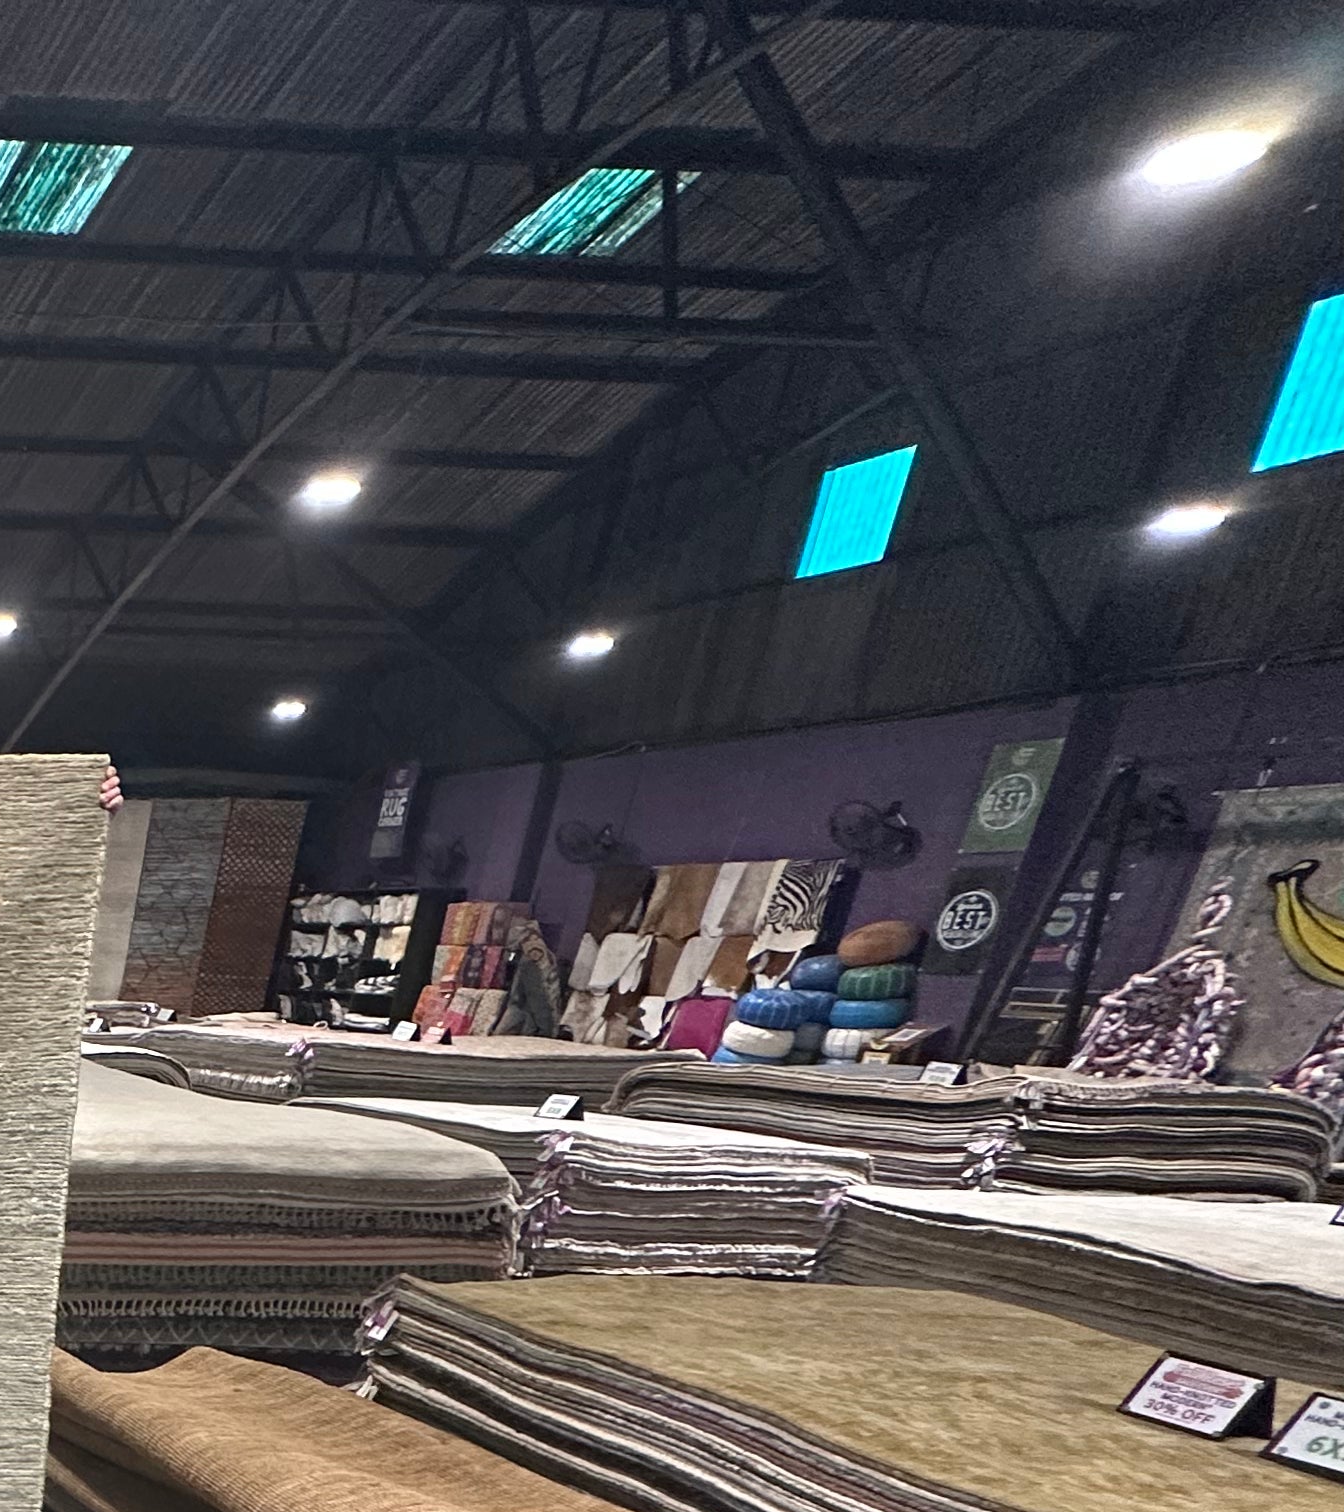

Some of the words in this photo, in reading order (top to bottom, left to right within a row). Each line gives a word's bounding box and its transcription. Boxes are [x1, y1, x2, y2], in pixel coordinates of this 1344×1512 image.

[942, 911, 986, 929] BEST
[1143, 1398, 1178, 1416] 30%
[1181, 1409, 1216, 1425] OFF
[1306, 1436, 1344, 1461] 6X
